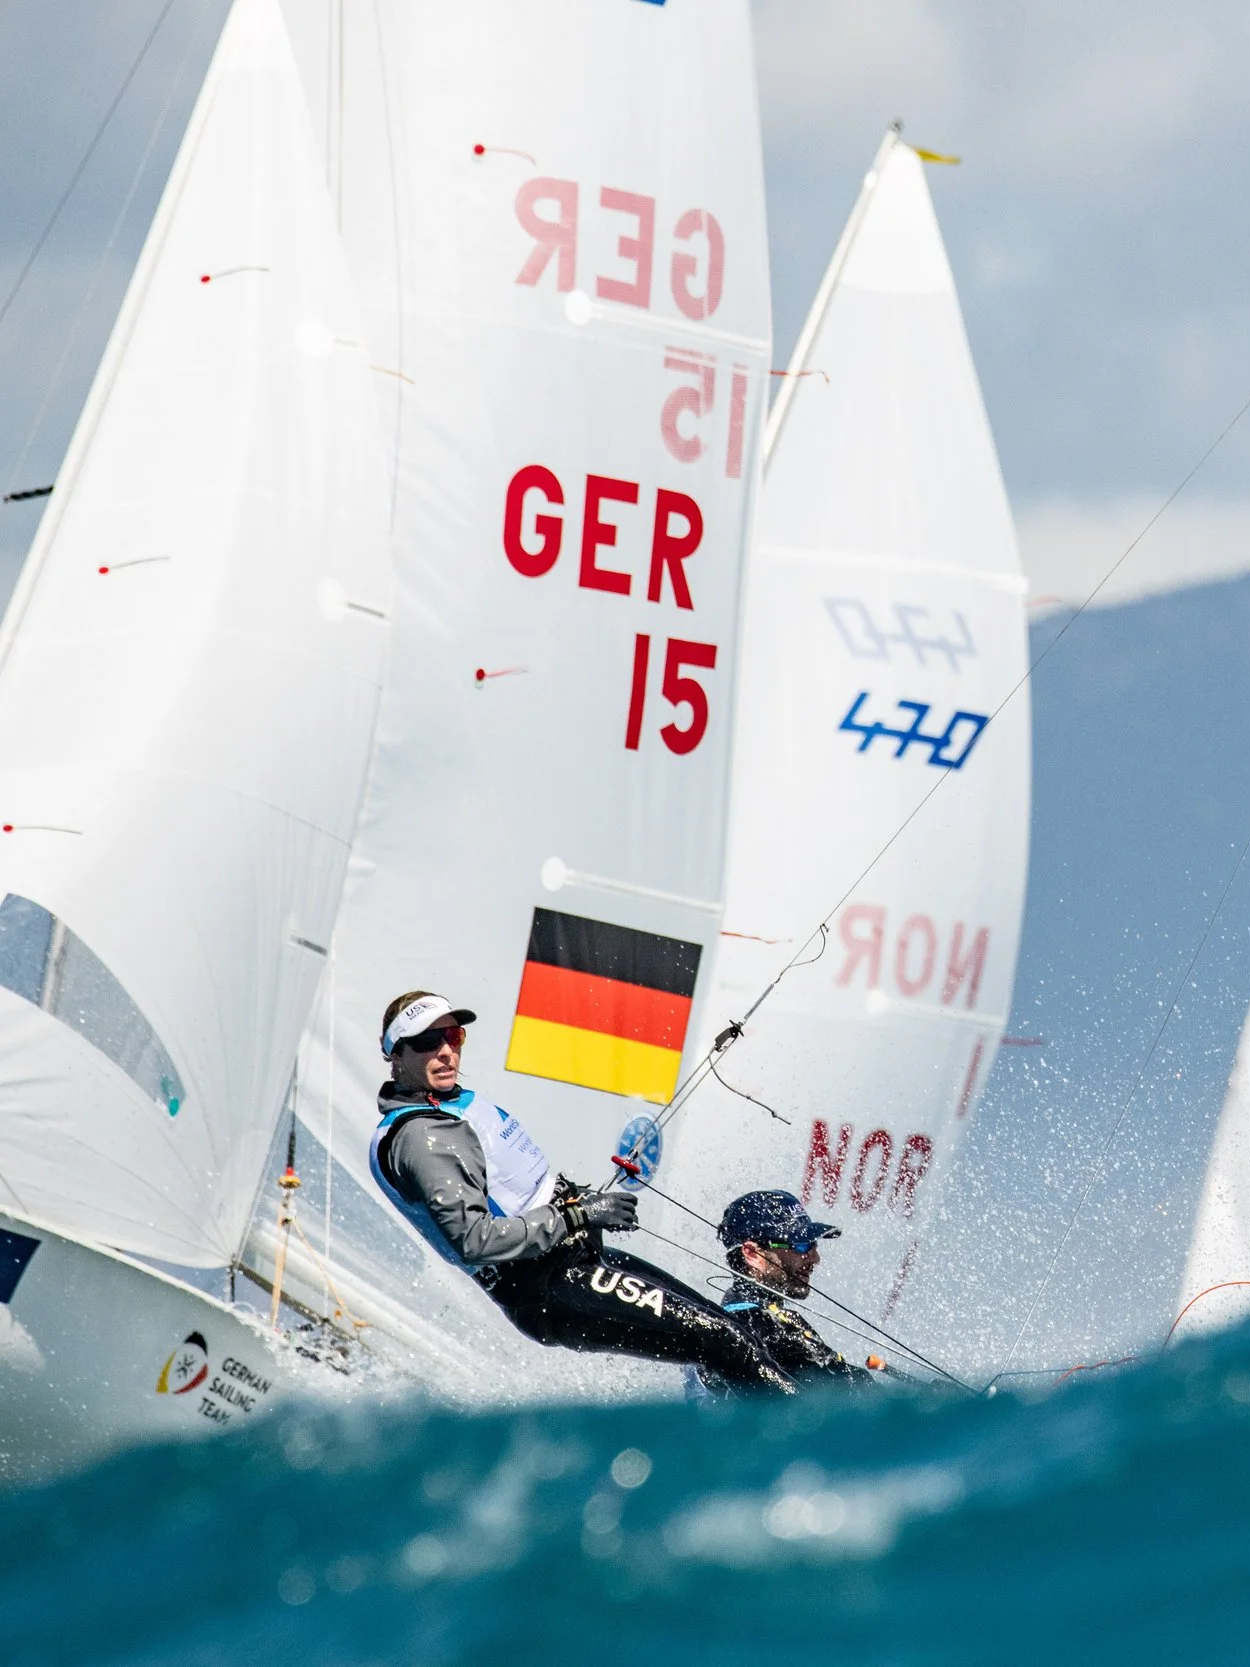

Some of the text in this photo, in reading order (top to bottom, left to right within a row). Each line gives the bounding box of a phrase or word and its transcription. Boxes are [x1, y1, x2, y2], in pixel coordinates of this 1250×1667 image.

[502, 464, 705, 612] GER
[624, 632, 718, 757] 15
[838, 690, 990, 771] 470
[800, 1119, 934, 1219] NOR
[590, 1266, 664, 1318] USA
[208, 1376, 256, 1413] SAILING
[222, 1357, 273, 1394] GERMAN
